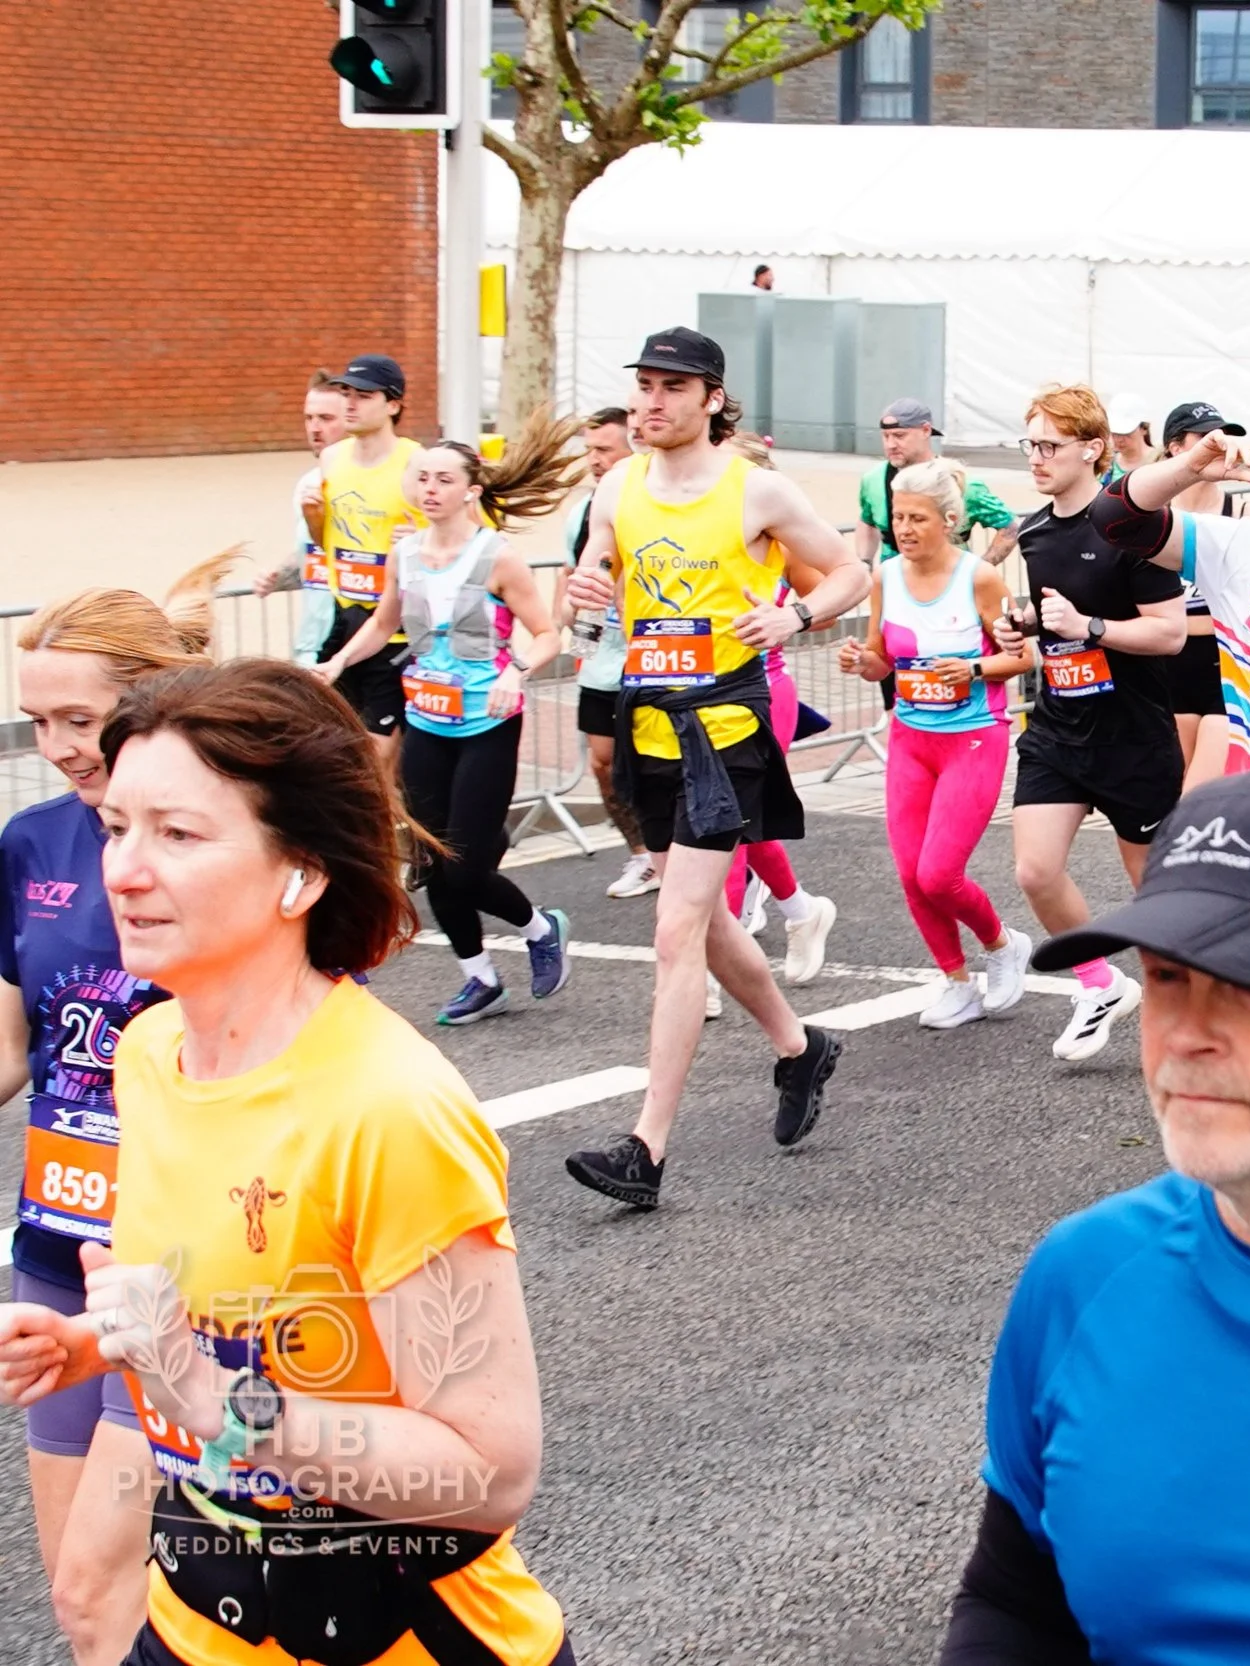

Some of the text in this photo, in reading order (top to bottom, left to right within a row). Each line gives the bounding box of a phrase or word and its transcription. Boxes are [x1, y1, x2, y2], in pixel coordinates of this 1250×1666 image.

[671, 557, 719, 571] Olwen
[640, 650, 697, 672] 6015
[1052, 663, 1096, 686] 6075
[911, 682, 956, 700] 2338
[42, 1160, 120, 1212] 859
